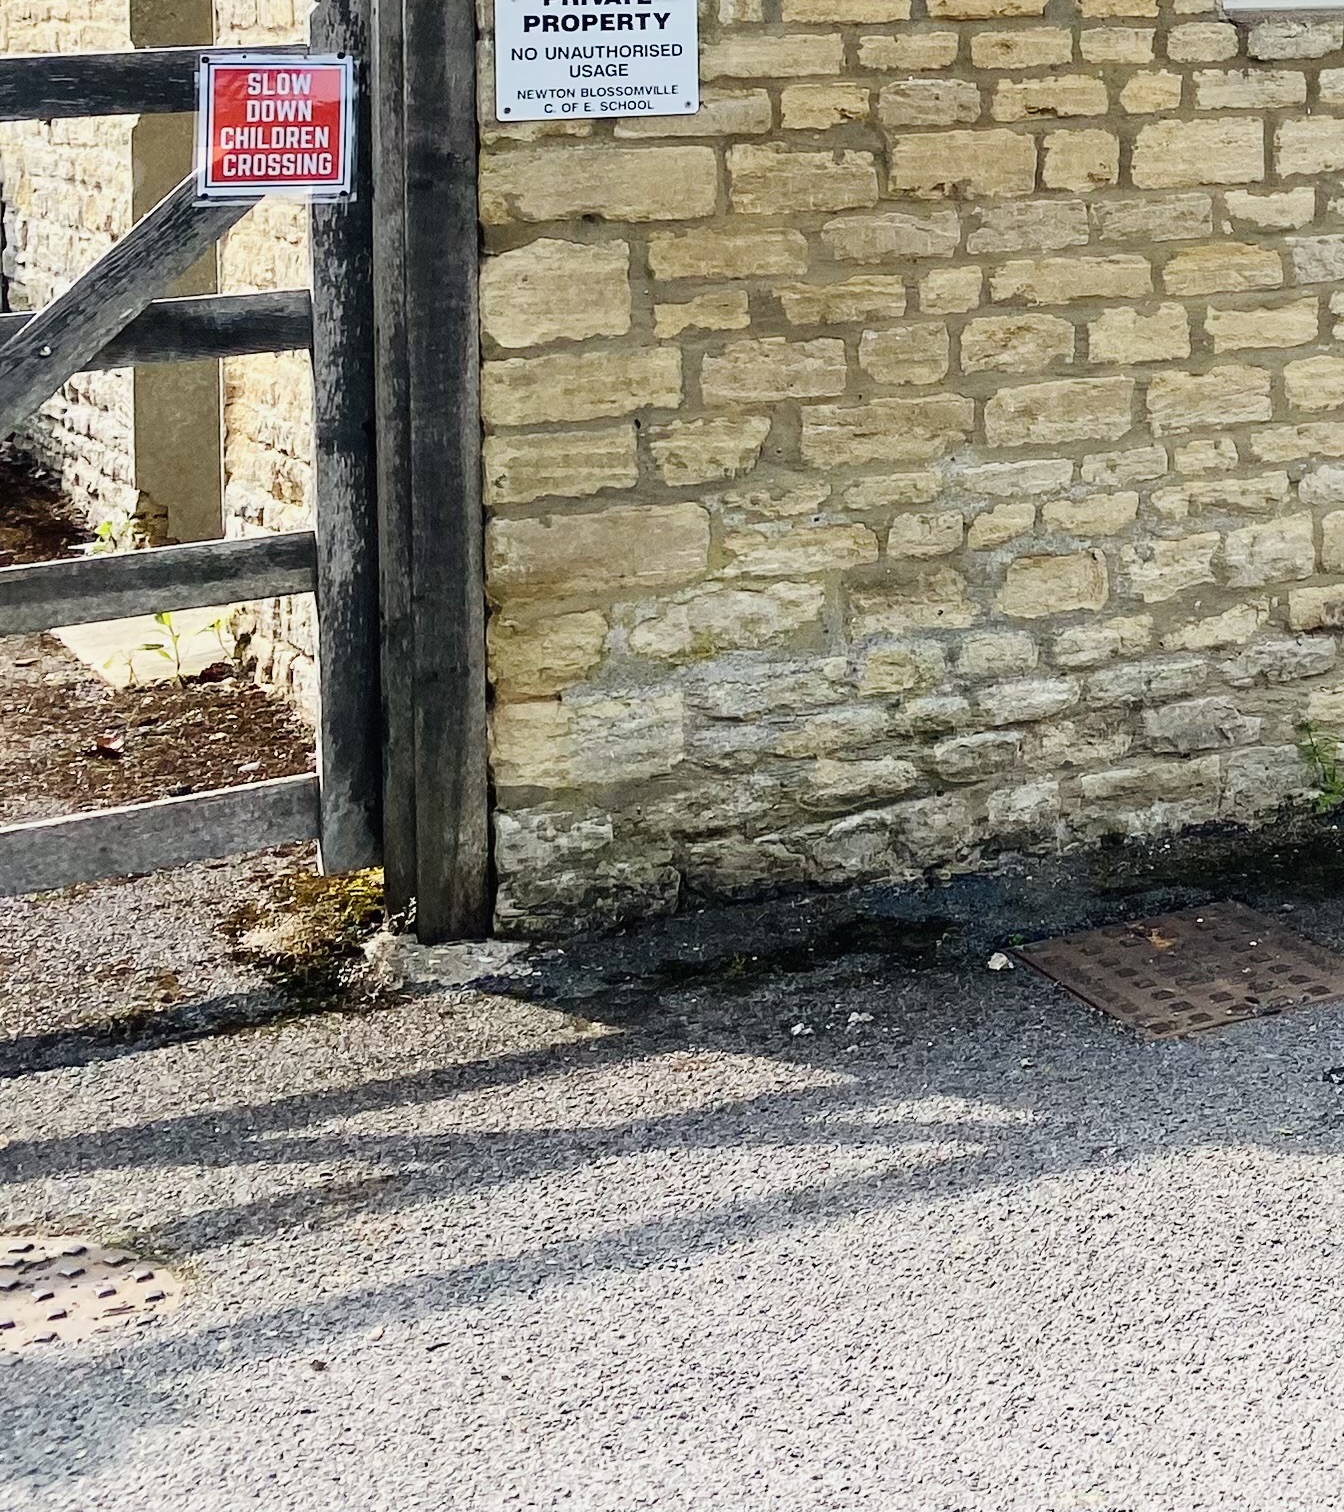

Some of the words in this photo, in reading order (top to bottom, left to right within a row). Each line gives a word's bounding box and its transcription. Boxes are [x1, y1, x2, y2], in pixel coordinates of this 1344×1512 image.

[523, 13, 671, 33] PROPERTY
[511, 47, 537, 61] NO
[545, 44, 683, 60] UNAUTHORISED
[569, 63, 629, 78] USAGE
[248, 73, 311, 95] SLOW
[517, 89, 576, 100] NEWTON
[580, 85, 679, 98] BLOSSOMVILLE
[246, 100, 312, 122] DOWN
[561, 103, 579, 113] OF
[600, 100, 655, 111] SCHOOL
[220, 127, 329, 149] CHILDREN
[222, 153, 333, 176] CROSSING
